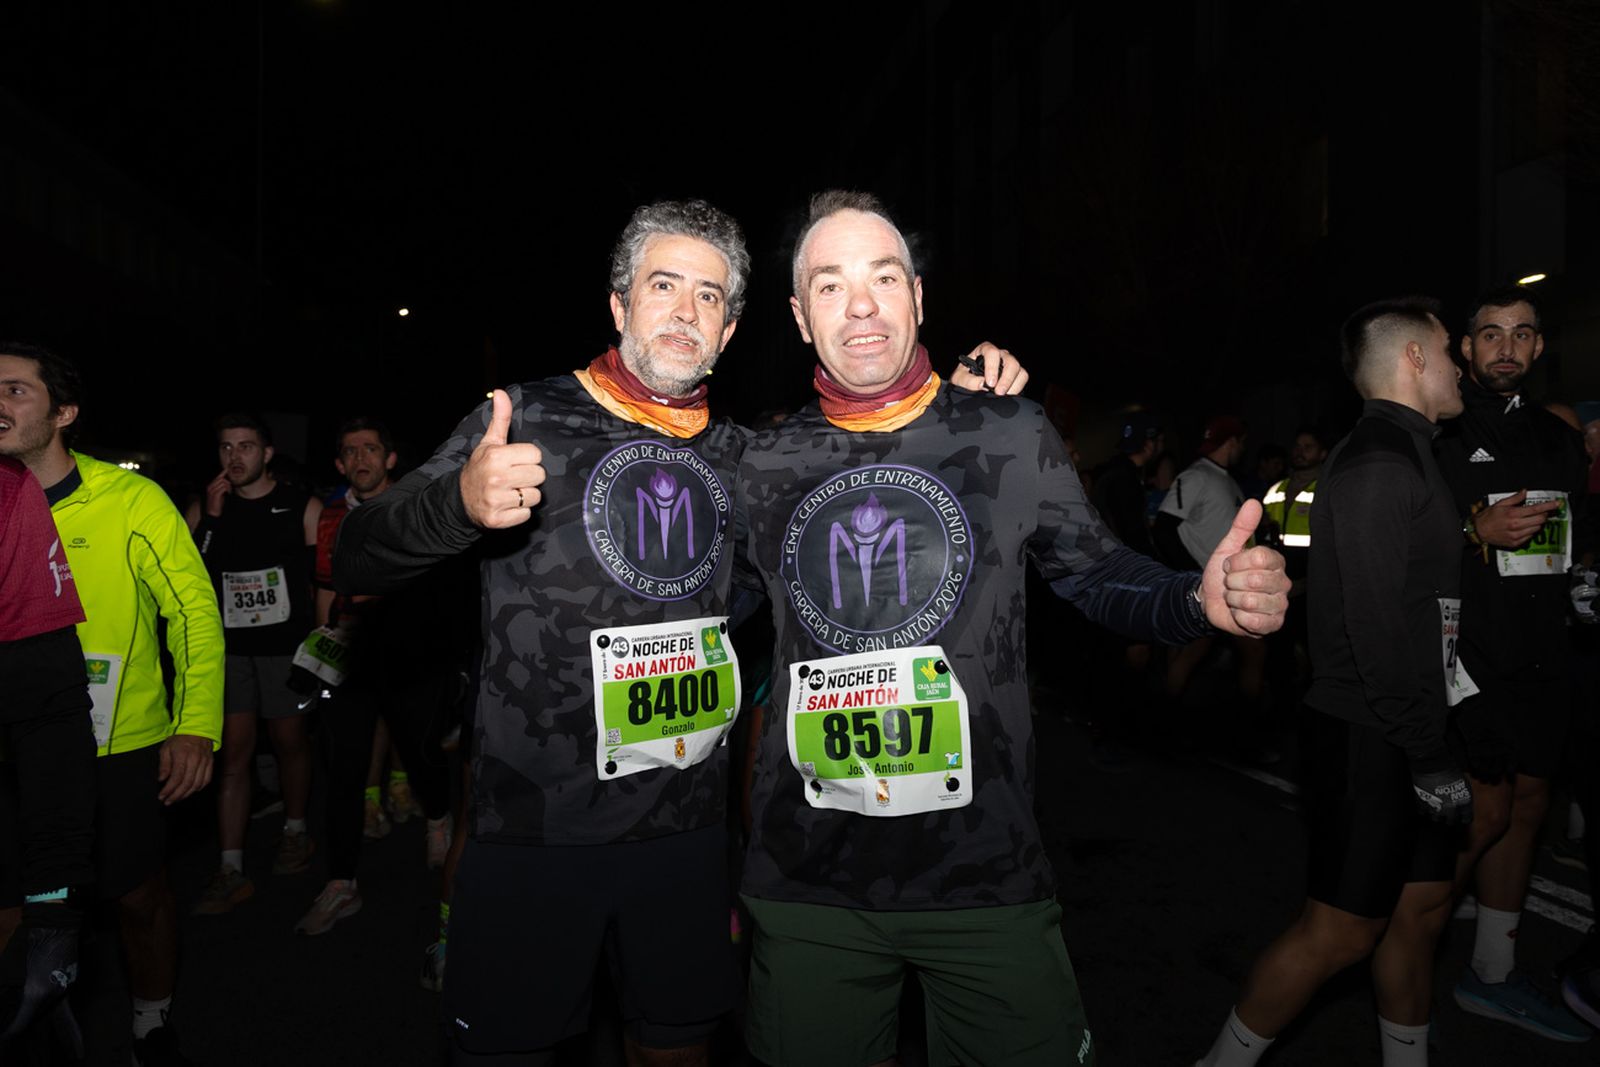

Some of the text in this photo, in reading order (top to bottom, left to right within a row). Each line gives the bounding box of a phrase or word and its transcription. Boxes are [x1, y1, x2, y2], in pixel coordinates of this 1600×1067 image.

[592, 445, 728, 512] EME CENTRO DE ENTRENAMIENTO
[785, 470, 967, 554] EME CENTRO DE ENTRENAMIENTO
[594, 529, 635, 584] CARRERA
[637, 579, 655, 594] DE
[657, 582, 682, 597] SAN
[685, 561, 713, 593] ANTÓN
[234, 589, 277, 609] 3348
[790, 571, 963, 653] CARRERA DE SAN ANTÓN 2026
[612, 637, 695, 658] 43 NOCHE DE
[614, 661, 646, 680] SAN
[648, 652, 697, 677] ANTÓN
[809, 667, 897, 690] 43 NOCHE DE
[628, 670, 719, 726] 8400
[806, 684, 899, 711] SAN ANTÓN
[661, 720, 695, 736] Gonzalo
[822, 706, 934, 762] 8597
[874, 761, 914, 774] Antonio
